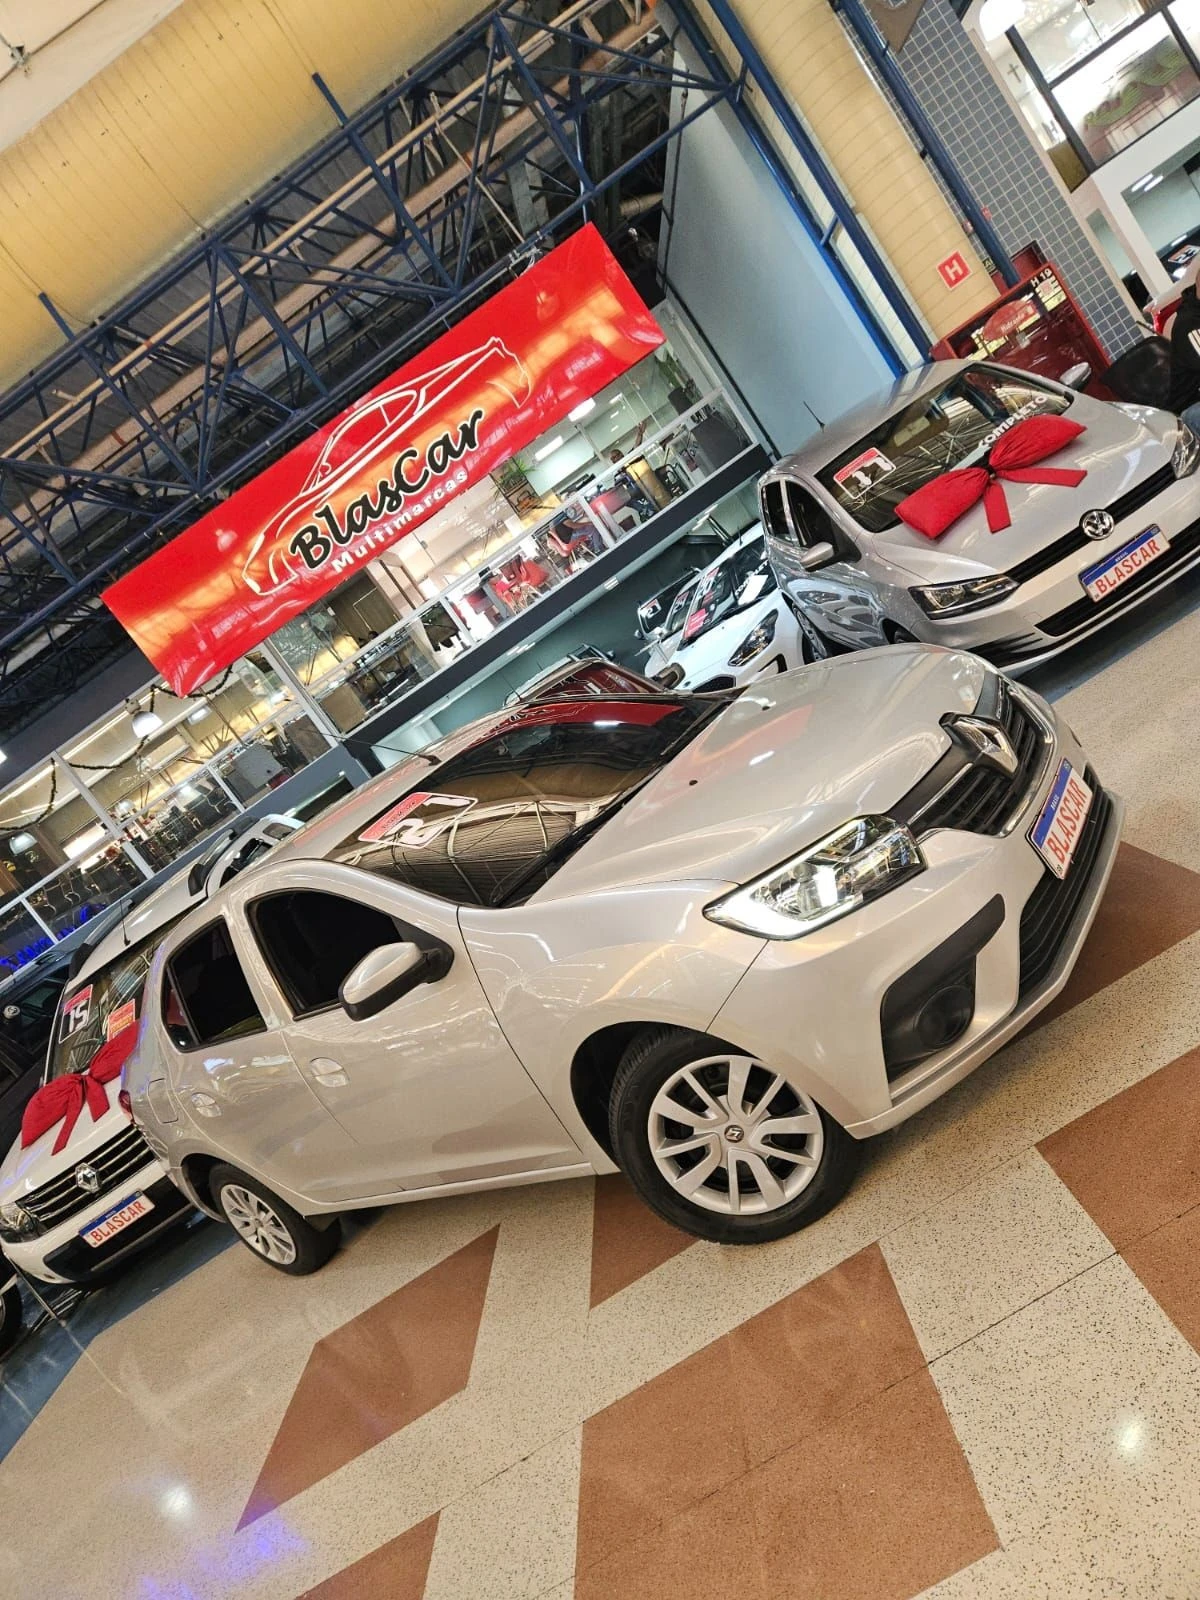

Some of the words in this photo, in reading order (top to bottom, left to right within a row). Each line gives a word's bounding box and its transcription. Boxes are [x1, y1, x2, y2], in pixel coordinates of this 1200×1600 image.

[945, 260, 963, 281] H
[1030, 278, 1041, 287] H
[1040, 268, 1052, 281] 19
[978, 396, 1048, 449] COMPLETO
[289, 410, 483, 568] BlasCar
[331, 469, 469, 574] Multimarcas
[1095, 539, 1160, 594] BLASCAR
[1046, 778, 1088, 864] BLASCAR
[68, 999, 88, 1033] 15
[91, 1201, 146, 1242] BLASCAR
